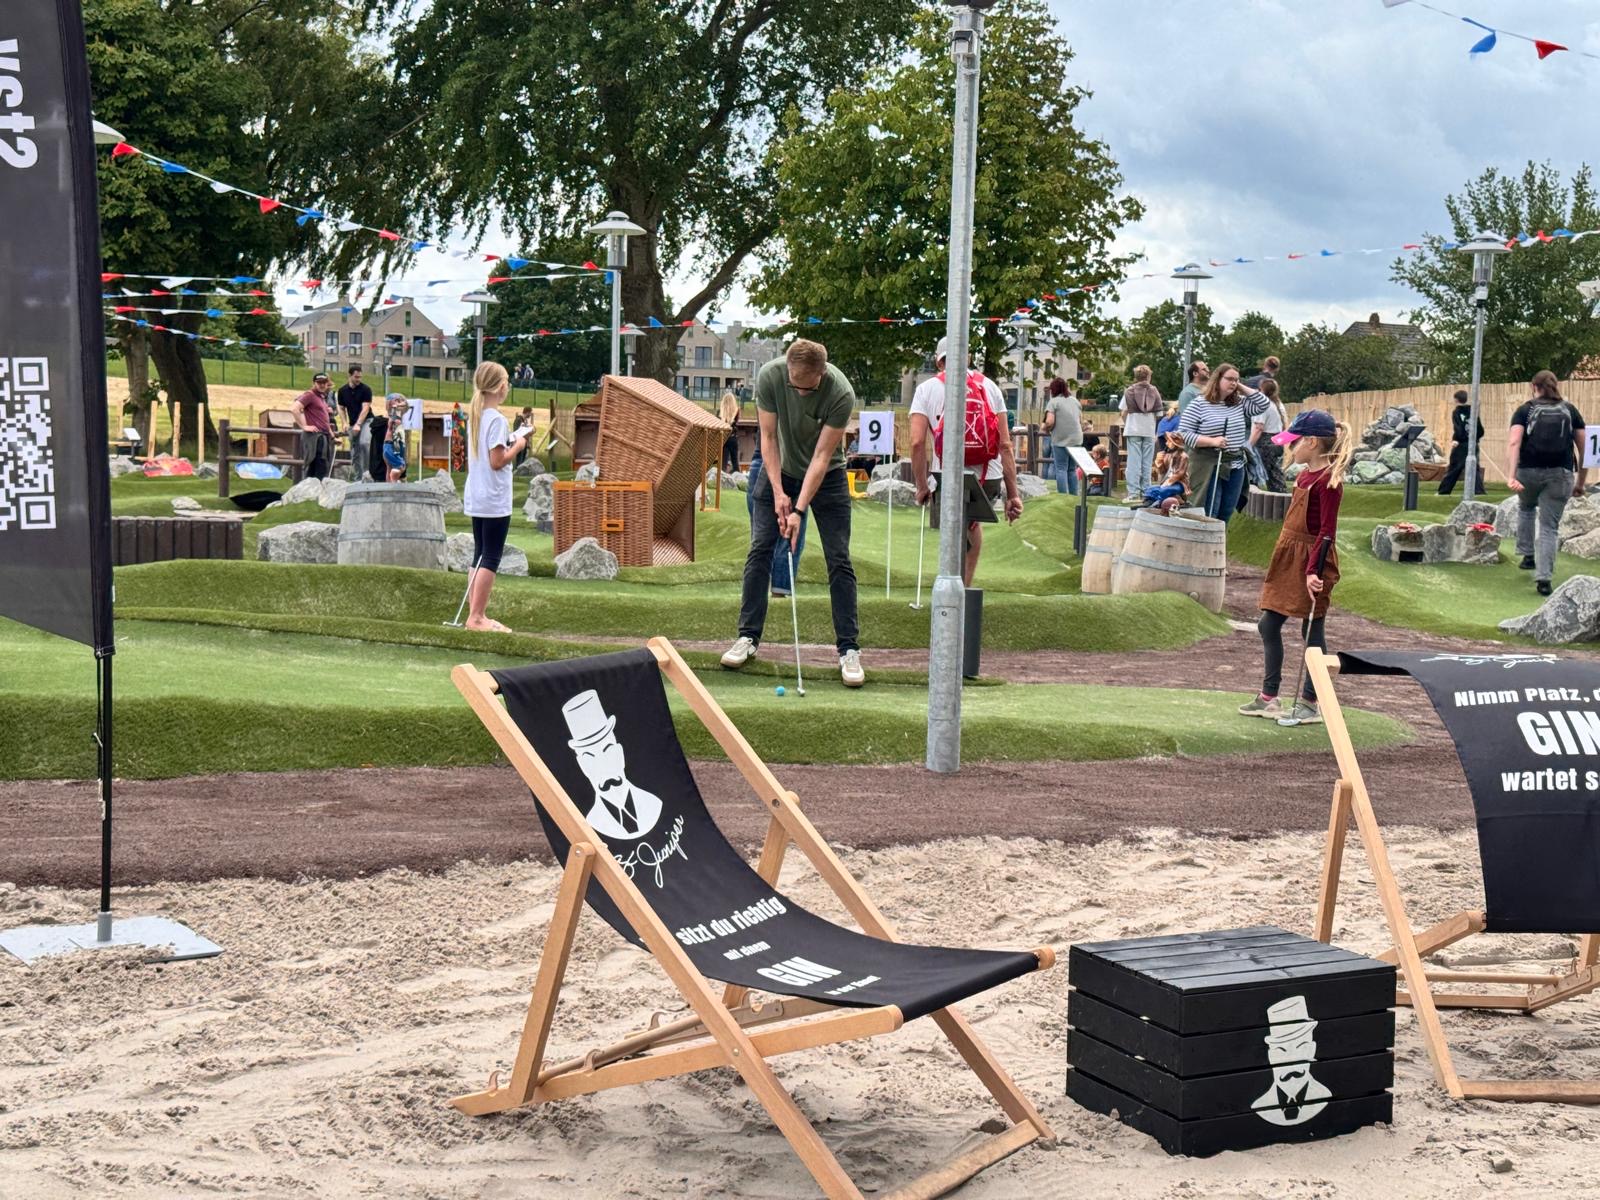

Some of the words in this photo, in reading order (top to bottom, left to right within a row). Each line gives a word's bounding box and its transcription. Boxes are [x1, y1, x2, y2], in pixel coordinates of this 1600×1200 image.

[868, 419, 882, 442] 9
[1454, 690, 1520, 707] Nimm
[1524, 687, 1590, 703] Platz,
[1516, 710, 1600, 756] GIN
[1501, 768, 1578, 792] wartet
[636, 814, 689, 889] Juniper
[675, 923, 716, 946] sitzt
[710, 918, 738, 937] du
[730, 896, 787, 930] richtig
[722, 949, 744, 961] mit
[739, 940, 772, 957] einem
[756, 956, 842, 987] GIN
